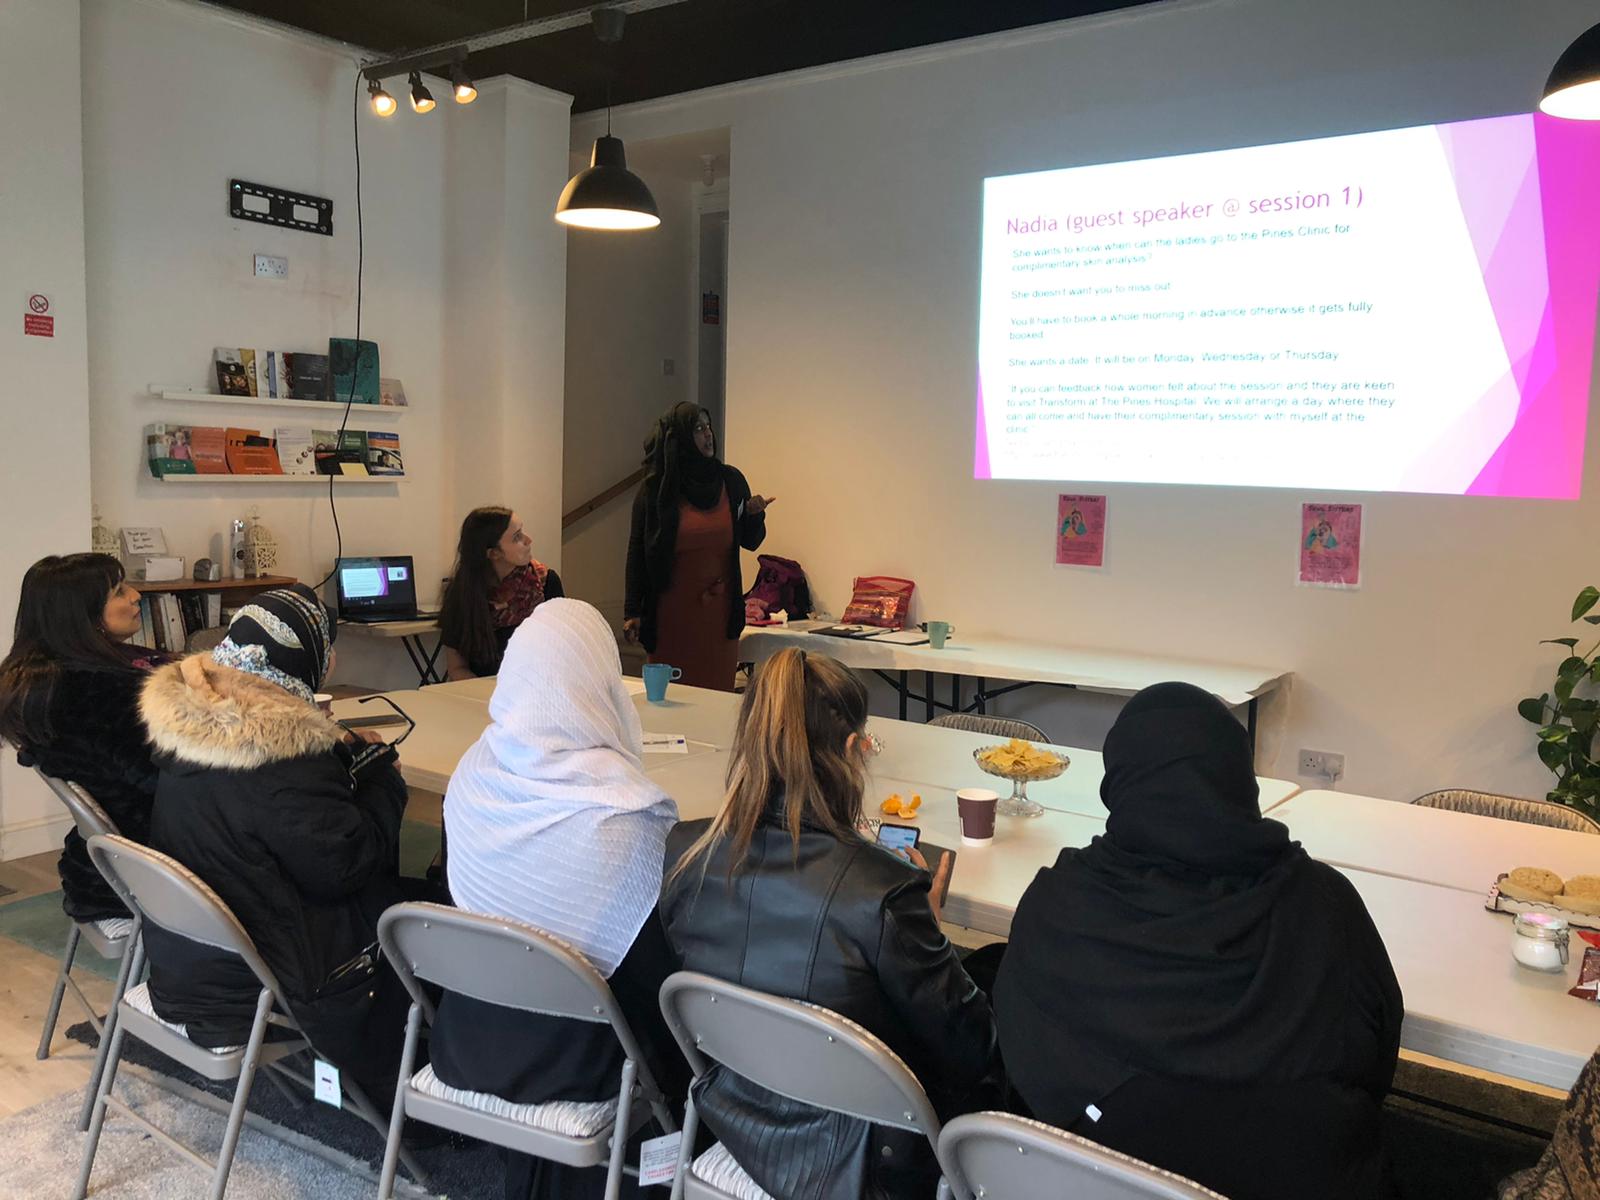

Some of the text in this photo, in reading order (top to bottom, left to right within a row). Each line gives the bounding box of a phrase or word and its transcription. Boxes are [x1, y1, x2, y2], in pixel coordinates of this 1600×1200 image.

[1007, 186, 1363, 235] Nadia (guest speaker @ session 1)
[1012, 223, 1350, 258] She wants to know when can the ladies go to the Pines Clinic for
[1012, 258, 1080, 272] complimentary
[1083, 257, 1103, 267] skin
[1011, 290, 1030, 300] She
[1032, 287, 1067, 298] doesnt
[1069, 286, 1092, 296] want
[1095, 286, 1113, 297] you
[1116, 284, 1126, 293] to
[1127, 282, 1152, 292] miss
[1010, 316, 1035, 327] Youll
[1037, 316, 1060, 326] have
[1063, 315, 1072, 324] to
[1074, 313, 1098, 324] book
[1110, 311, 1139, 322] whole
[1142, 310, 1185, 322] morning
[1199, 307, 1246, 318] advance
[1249, 304, 1305, 316] otherwise
[1319, 303, 1345, 316] gets
[1348, 301, 1373, 314] fully
[1008, 357, 1027, 367] She
[1029, 356, 1056, 367] wants
[1104, 354, 1120, 364] will
[1122, 355, 1136, 364] be
[1138, 355, 1151, 364] on
[1201, 351, 1265, 363] Wednesday
[1269, 351, 1280, 361] or
[1019, 386, 1036, 395] you
[1038, 384, 1055, 394] can
[1058, 383, 1101, 393] feedback
[1104, 383, 1124, 392] how
[1128, 383, 1164, 392] women
[1168, 382, 1183, 392] felt
[1187, 382, 1217, 392] about
[1220, 381, 1236, 391] the
[1240, 381, 1282, 391] session
[1286, 381, 1308, 391] and
[1312, 381, 1336, 392] they
[1340, 382, 1360, 391] are
[1364, 380, 1395, 391] keen
[1007, 398, 1016, 408] to
[1018, 398, 1036, 407] visit
[1039, 397, 1086, 407] Transform
[1088, 397, 1099, 407] at
[1101, 396, 1119, 407] The
[1122, 396, 1151, 407] Pines
[1203, 396, 1221, 406] We
[1224, 396, 1241, 406] will
[1244, 397, 1287, 409] arrange
[1302, 396, 1323, 408] day
[1327, 396, 1364, 407] where
[1368, 396, 1396, 409] they
[1006, 411, 1365, 424] can all come and have their complimentary session with myself at the
